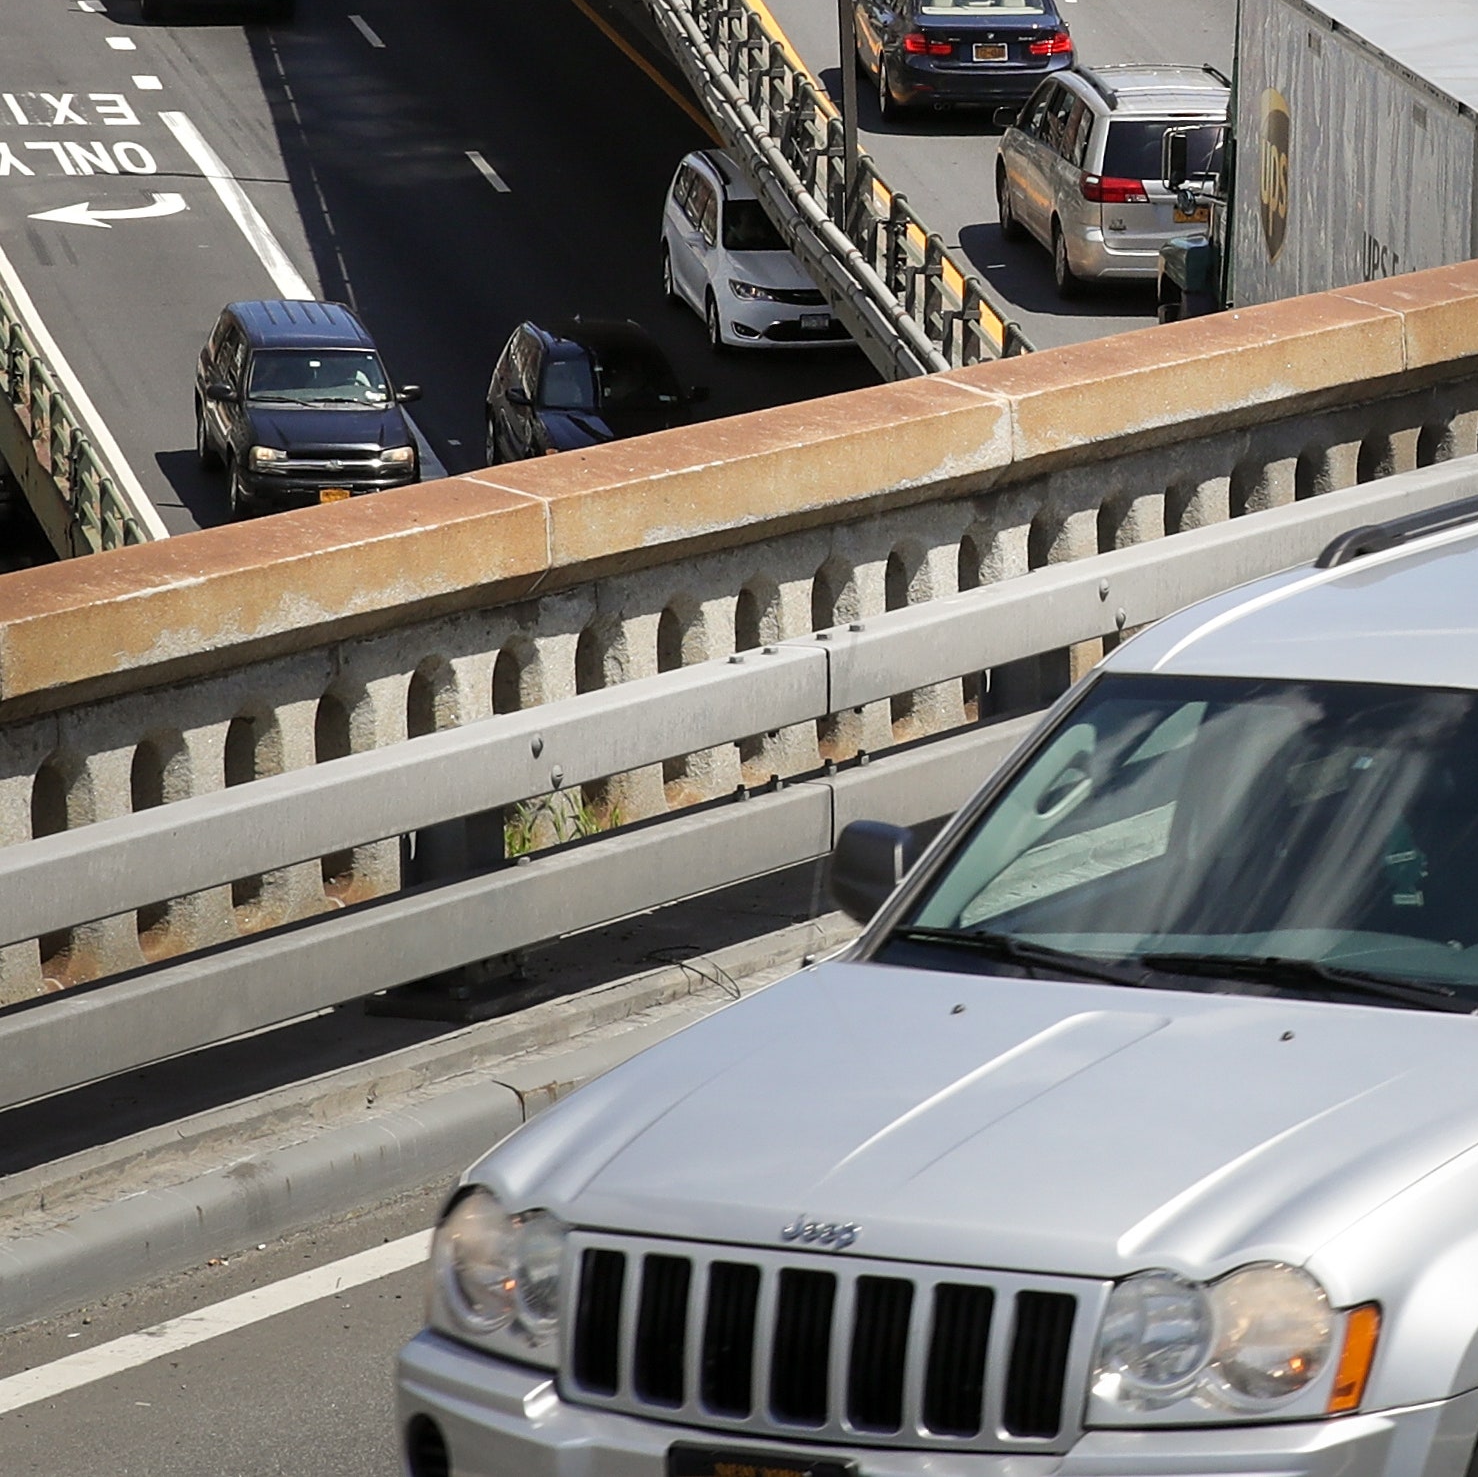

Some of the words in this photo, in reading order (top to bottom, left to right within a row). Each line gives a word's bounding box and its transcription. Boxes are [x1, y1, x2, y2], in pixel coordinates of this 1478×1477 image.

[2, 93, 141, 125] EXI
[1261, 138, 1287, 236] ups
[1363, 231, 1387, 282] UPS
[782, 1213, 862, 1250] Jeep
